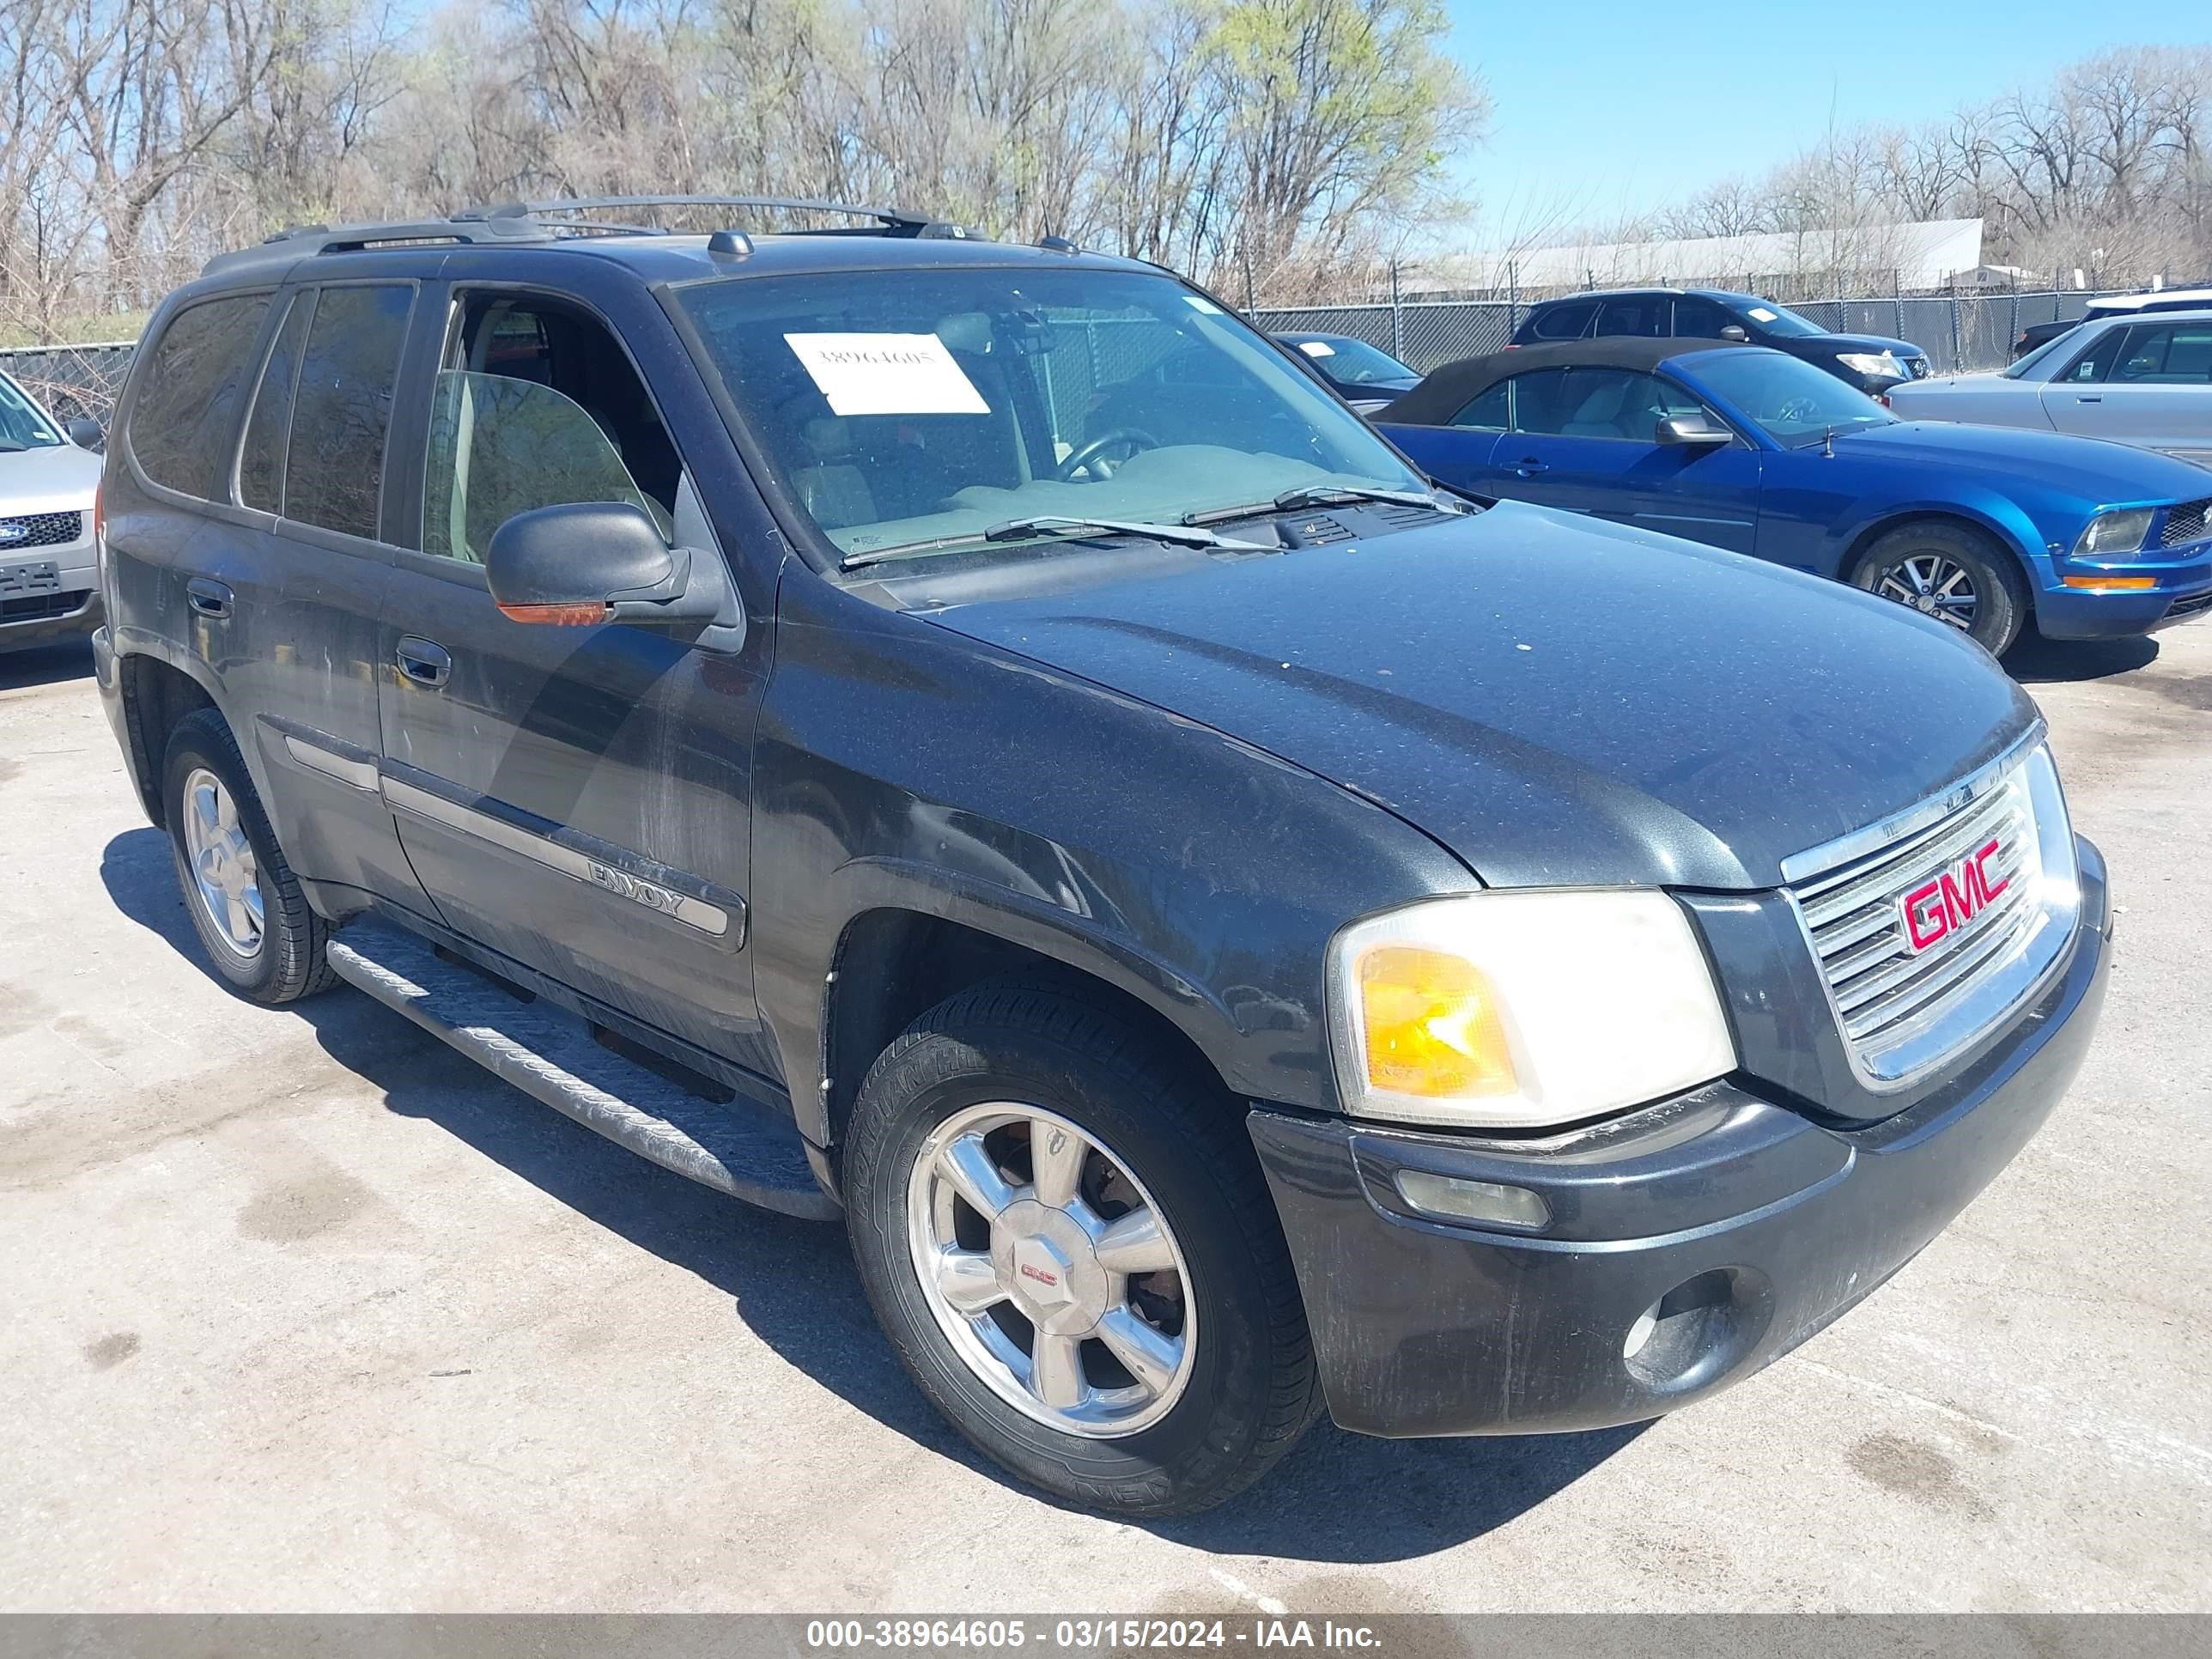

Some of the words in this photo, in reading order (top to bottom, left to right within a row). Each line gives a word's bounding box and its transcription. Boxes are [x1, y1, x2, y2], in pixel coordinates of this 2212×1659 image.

[818, 350, 936, 364] 38964605
[587, 860, 684, 915] ENVOY
[1901, 837, 2010, 952] GMC
[1021, 1263, 1058, 1286] GMC
